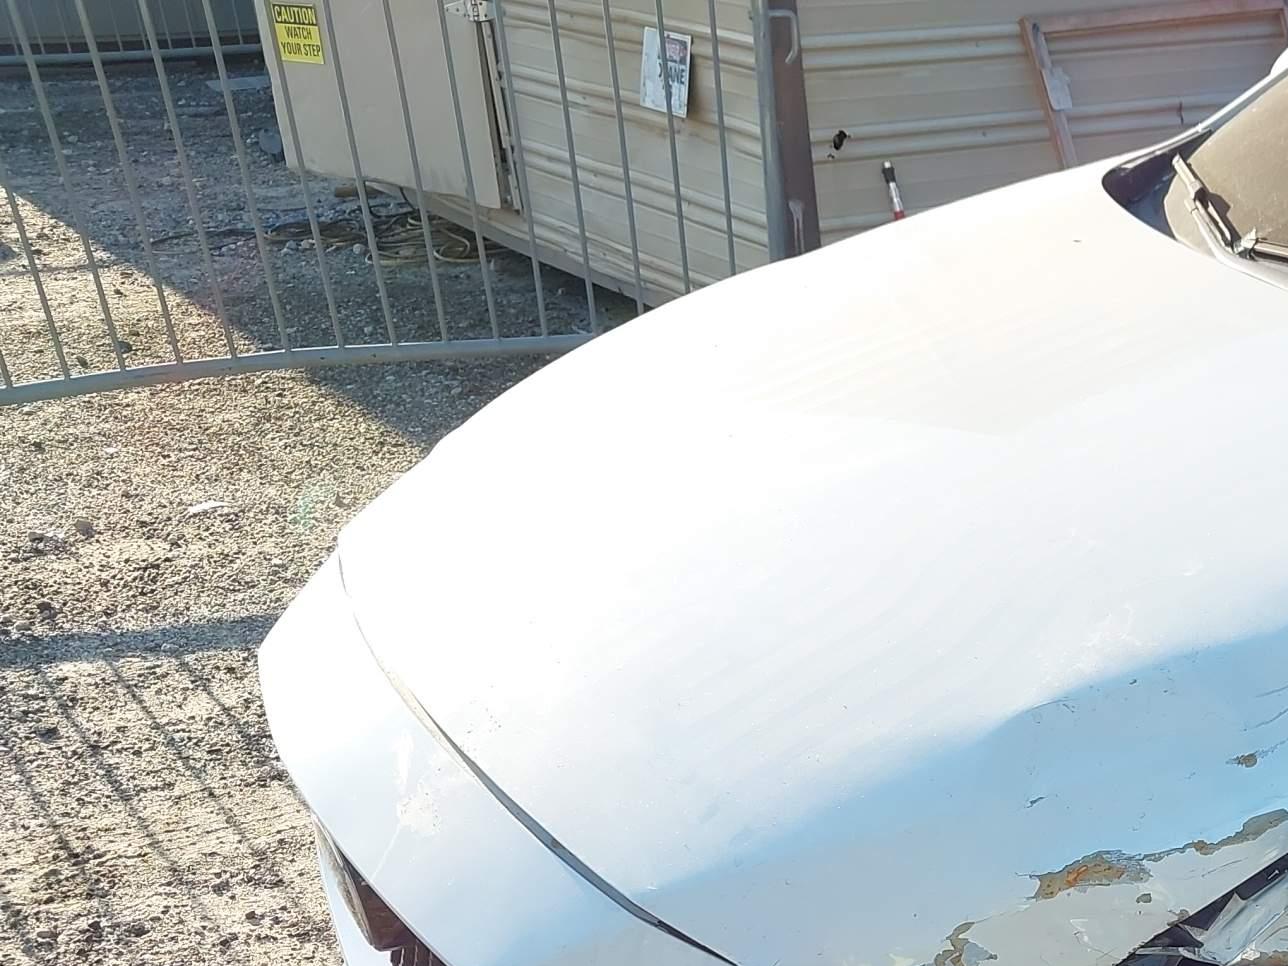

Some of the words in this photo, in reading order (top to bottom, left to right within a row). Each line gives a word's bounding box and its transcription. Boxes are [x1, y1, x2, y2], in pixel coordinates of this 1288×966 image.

[274, 5, 317, 25] CAUTION
[285, 25, 313, 40] WATCH
[281, 41, 303, 56] YOUR
[302, 43, 321, 57] STEP
